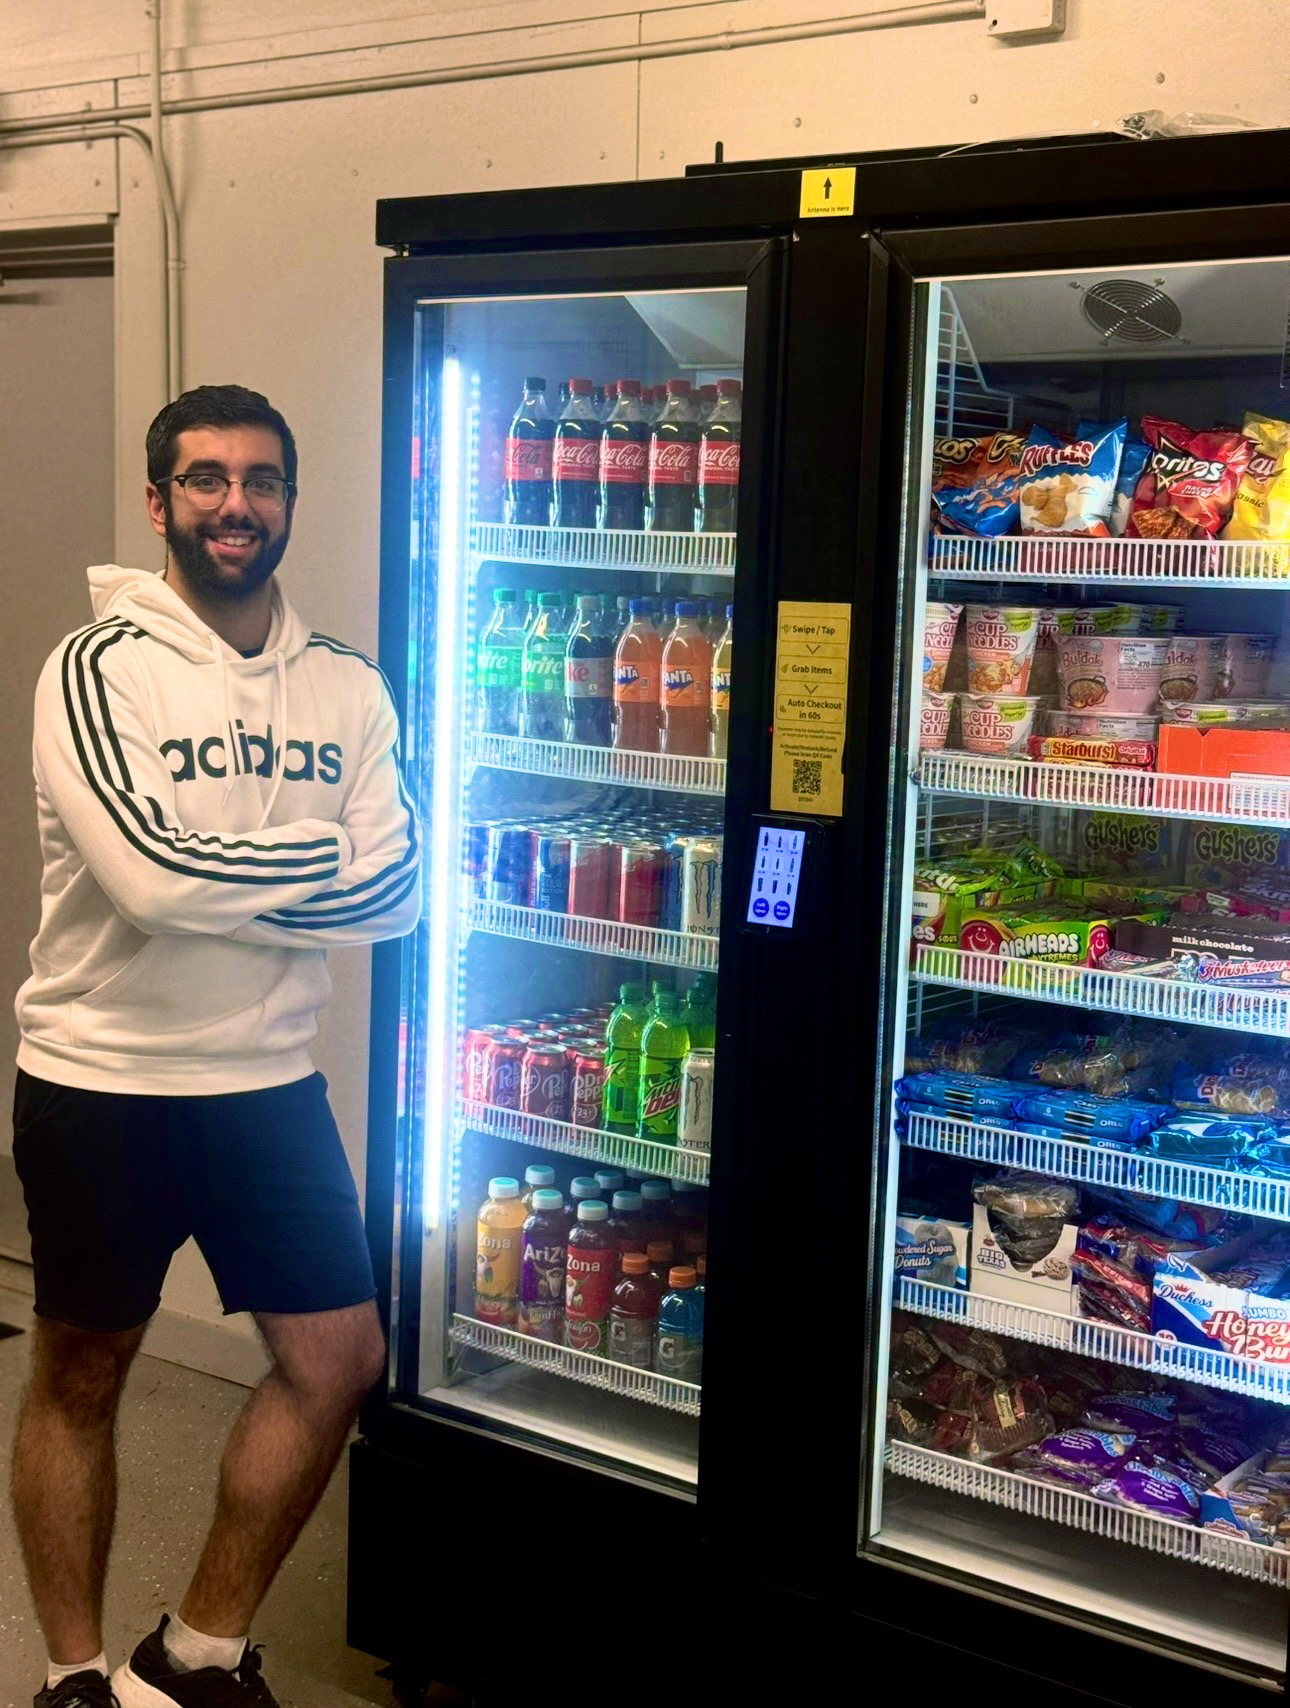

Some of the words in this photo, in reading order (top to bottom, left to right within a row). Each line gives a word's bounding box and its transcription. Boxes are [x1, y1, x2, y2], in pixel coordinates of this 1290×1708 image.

[793, 625, 815, 635] Swipe
[821, 625, 835, 636] Tap
[974, 621, 1009, 636] CUP
[967, 633, 1018, 651] NOODLES
[1062, 650, 1102, 668] Buldak
[791, 664, 809, 674] Grab
[811, 665, 832, 675] Items
[788, 699, 805, 707] Auto
[806, 700, 842, 710] Checkout
[799, 711, 807, 719] in
[808, 712, 821, 720] 60s
[969, 711, 1003, 726] CUP
[961, 724, 1013, 740] NOODLES
[158, 718, 343, 785] adidas
[1051, 741, 1117, 761] Starburst
[1119, 747, 1147, 755] Original
[1083, 819, 1161, 855] Gushers
[1195, 826, 1280, 865] Gushers
[912, 924, 936, 941] es
[999, 932, 1080, 958] AIRHEADS
[1172, 935, 1199, 946] milk
[1199, 939, 1255, 953] chocolate
[978, 1098, 1001, 1106] OREO
[979, 1117, 1002, 1126] OREO
[1100, 1119, 1123, 1128] OREO
[1097, 1140, 1122, 1149] OREO
[927, 1239, 954, 1256] Sugar
[980, 1248, 1004, 1260] BIG
[894, 1254, 932, 1269] Donuts
[977, 1256, 1006, 1269] TEXAS
[1159, 1283, 1214, 1308] Duchess
[1241, 1306, 1287, 1320] JUMBO
[610, 1321, 626, 1342] G
[1204, 1311, 1290, 1345] Honey
[660, 1337, 675, 1359] G
